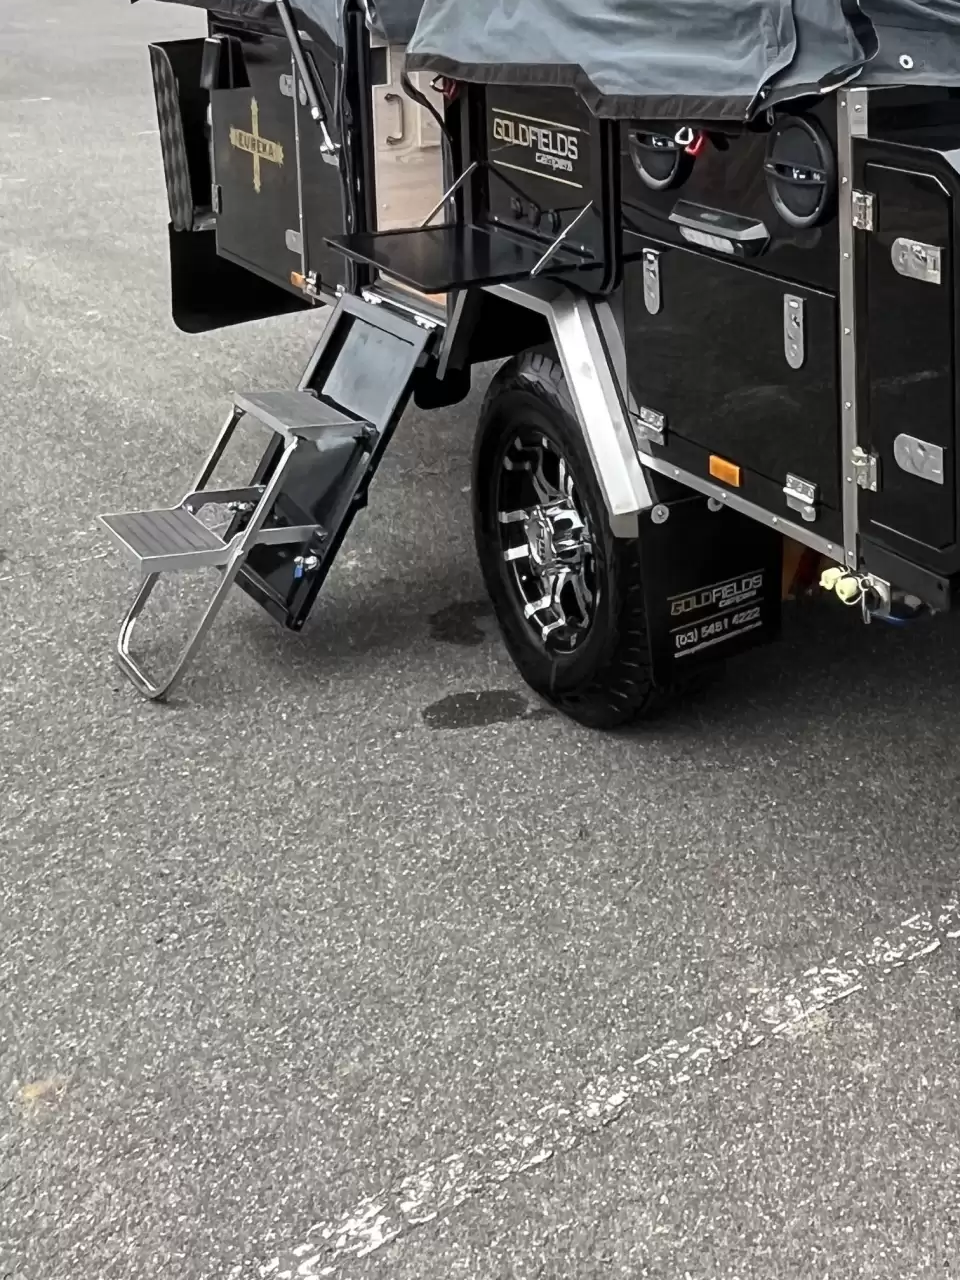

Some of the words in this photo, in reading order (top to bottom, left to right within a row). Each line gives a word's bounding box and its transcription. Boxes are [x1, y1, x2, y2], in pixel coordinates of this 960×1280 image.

[493, 117, 578, 160] GOLDFIELDS
[670, 574, 763, 616] GOLDFIELDS
[675, 628, 699, 649] (03)
